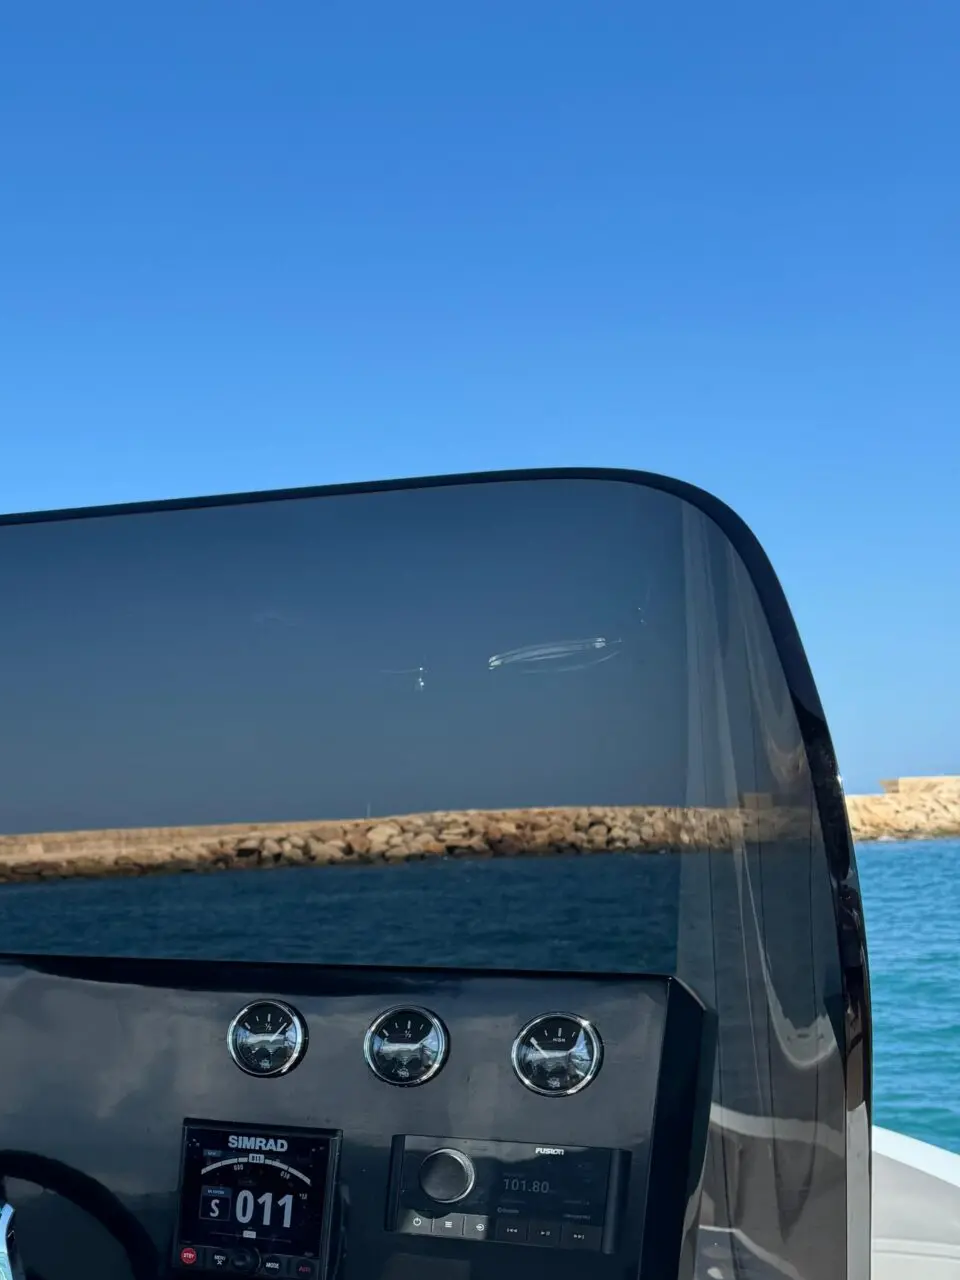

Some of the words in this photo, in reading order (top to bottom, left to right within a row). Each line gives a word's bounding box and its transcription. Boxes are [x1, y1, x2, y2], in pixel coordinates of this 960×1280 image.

[228, 1135, 288, 1152] SIMRAD
[503, 1179, 550, 1194] 101.80
[210, 1198, 220, 1218] S
[236, 1189, 294, 1229] 011
